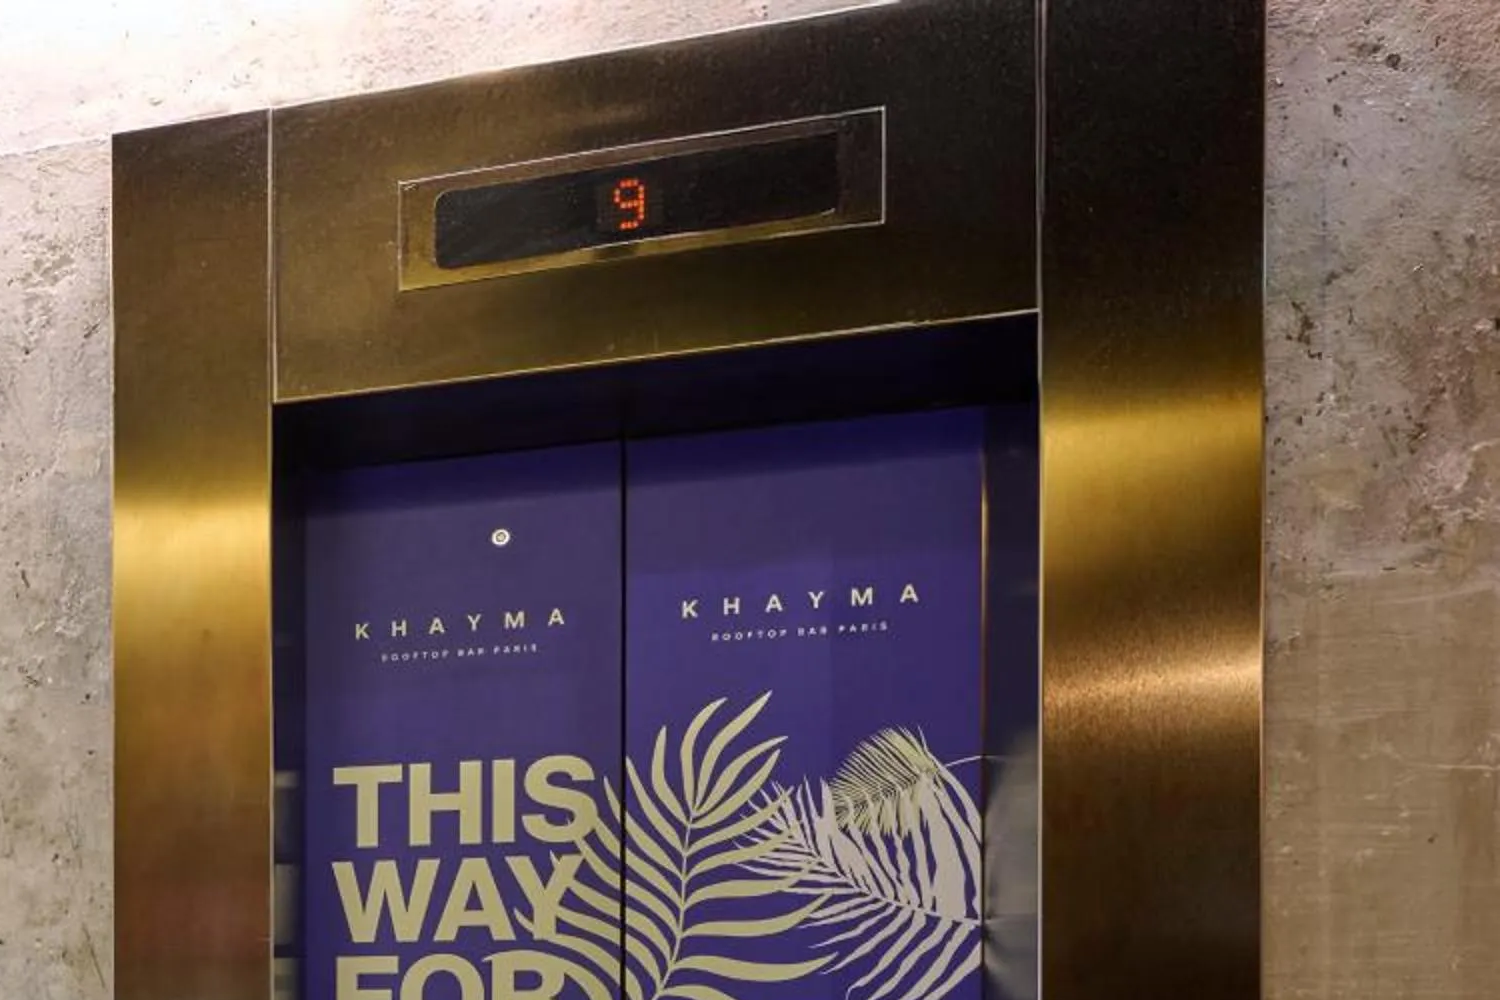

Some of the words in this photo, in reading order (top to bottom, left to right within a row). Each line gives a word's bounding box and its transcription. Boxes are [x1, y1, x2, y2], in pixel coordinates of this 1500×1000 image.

[613, 177, 645, 230] 9
[681, 583, 919, 618] KHAYMA
[355, 607, 565, 640] KHAYMA
[711, 628, 787, 641] ROOFTOP
[797, 626, 828, 637] BAR
[838, 621, 888, 633] PARIS
[381, 650, 450, 663] ROOFTOP
[493, 643, 537, 655] PARIS
[333, 755, 598, 847] THIS
[332, 854, 584, 942] WAY
